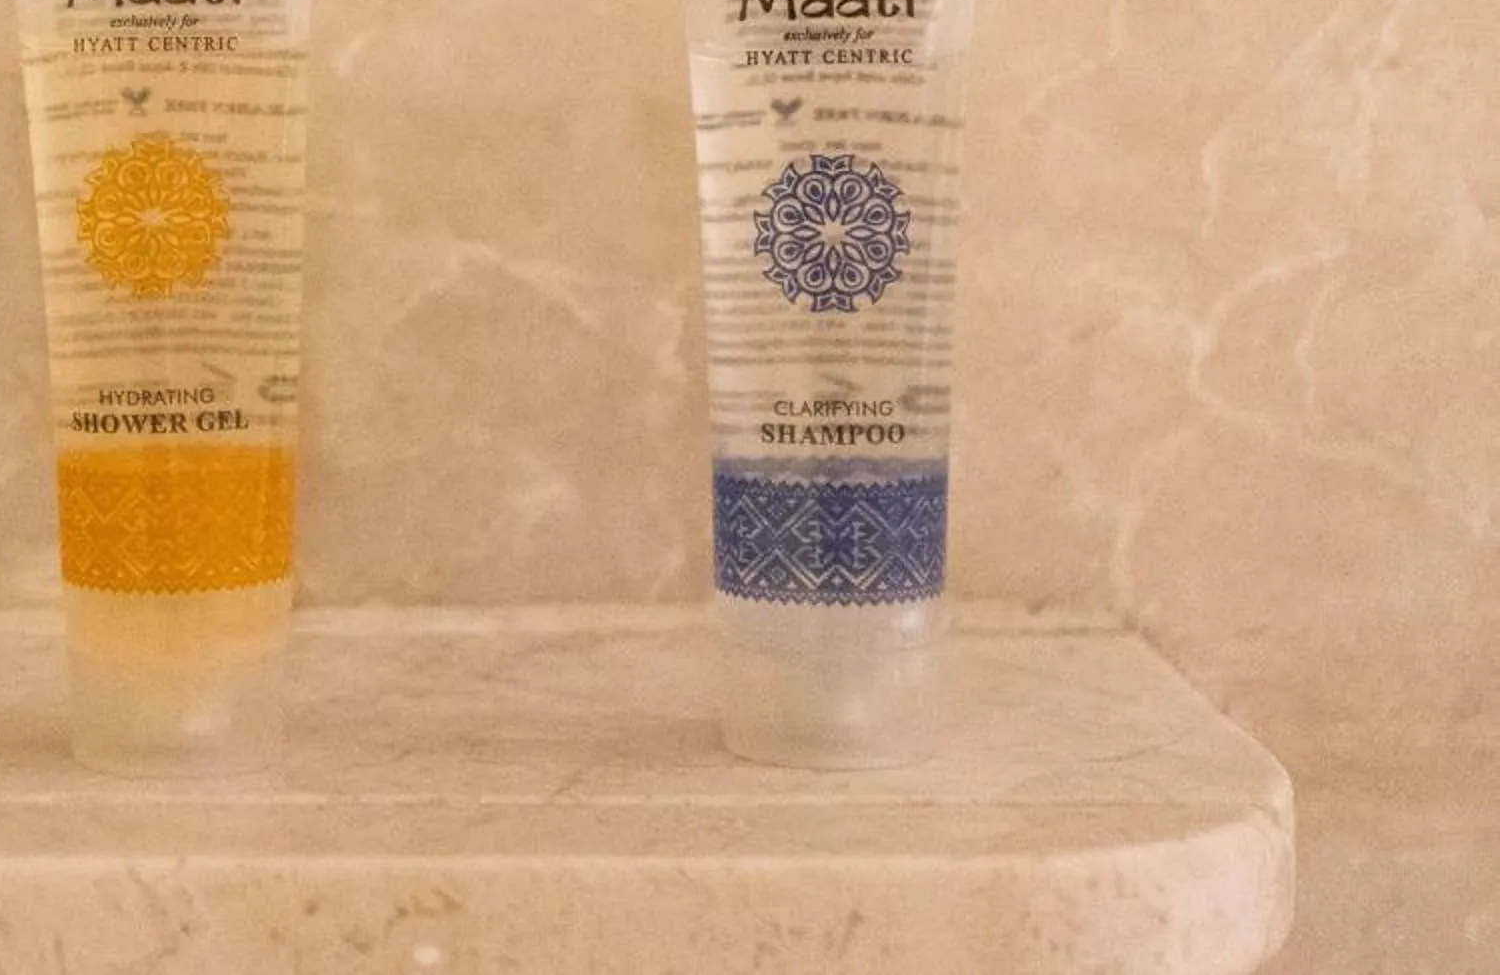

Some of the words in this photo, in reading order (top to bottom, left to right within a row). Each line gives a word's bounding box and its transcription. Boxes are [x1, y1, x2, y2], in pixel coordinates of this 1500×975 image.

[110, 14, 177, 30] exclusively
[179, 14, 200, 30] for
[783, 27, 851, 42] exclusively
[854, 26, 874, 42] for
[73, 37, 139, 53] HYATT
[148, 36, 240, 52] CENTRIC
[746, 49, 813, 66] HYATT
[822, 48, 913, 65] CENTRIC
[100, 388, 215, 406] HYDRATING
[774, 400, 894, 417] CLARIFYING
[72, 411, 189, 434] SHOWER
[196, 408, 250, 432] GEL
[761, 423, 906, 446] SHAMPOO
